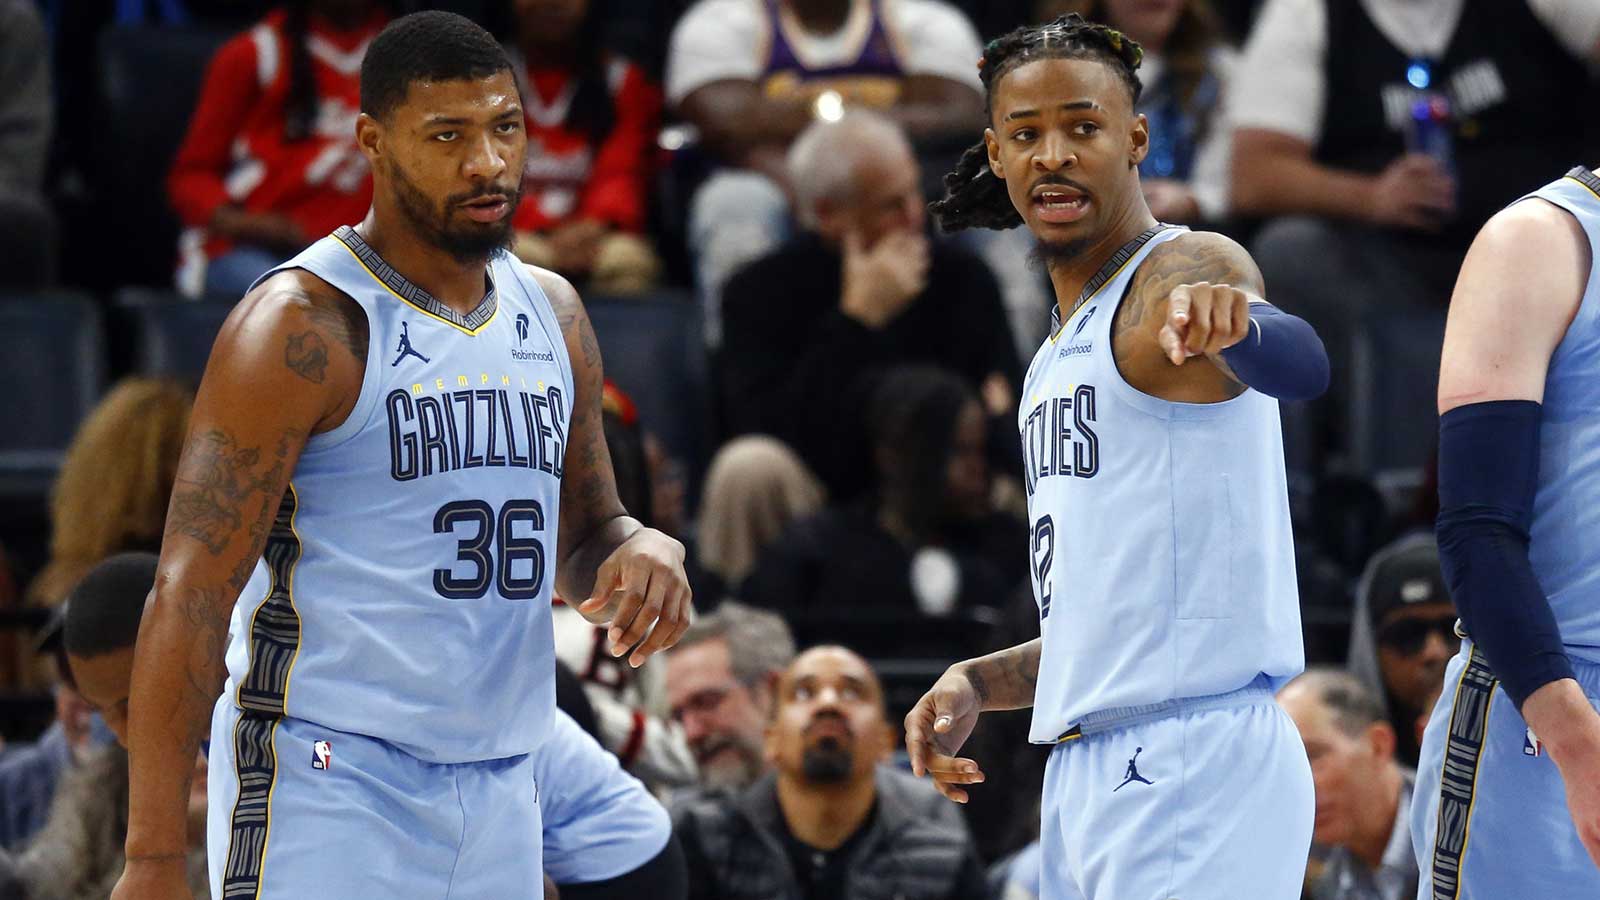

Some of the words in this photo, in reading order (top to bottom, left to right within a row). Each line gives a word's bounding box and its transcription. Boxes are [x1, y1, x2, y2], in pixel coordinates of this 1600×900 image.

[412, 373, 545, 395] MEMPHIS
[511, 349, 554, 361] Robinhood
[386, 385, 566, 482] GRIZZLIES
[433, 499, 545, 600] 36
